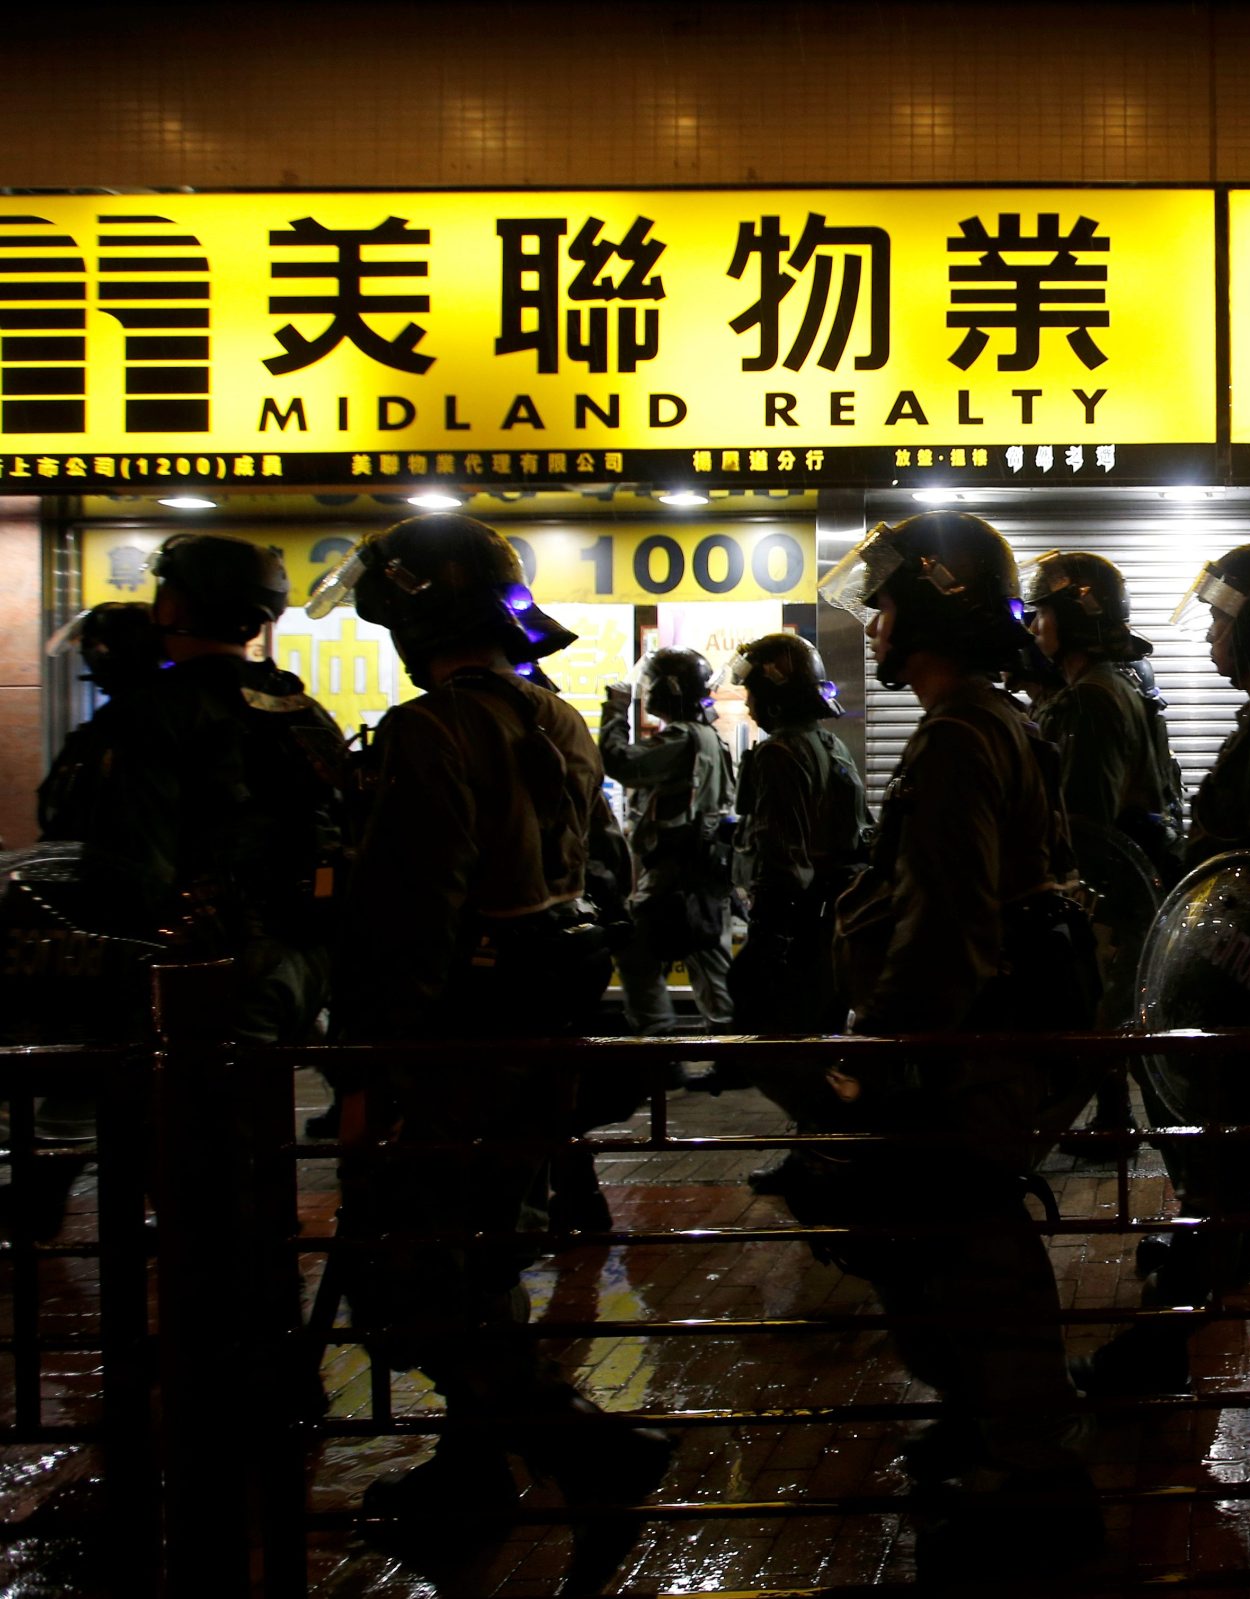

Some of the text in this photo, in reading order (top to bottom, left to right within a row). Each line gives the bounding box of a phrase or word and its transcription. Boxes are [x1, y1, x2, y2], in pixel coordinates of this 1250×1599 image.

[261, 212, 1110, 376] 美聯物業
[258, 389, 1109, 432] MIDLAND REALTY
[0, 455, 283, 479] 上市公司(1200)成員
[351, 452, 624, 476] 美聯物業代理有限公司
[580, 533, 805, 595] 1000
